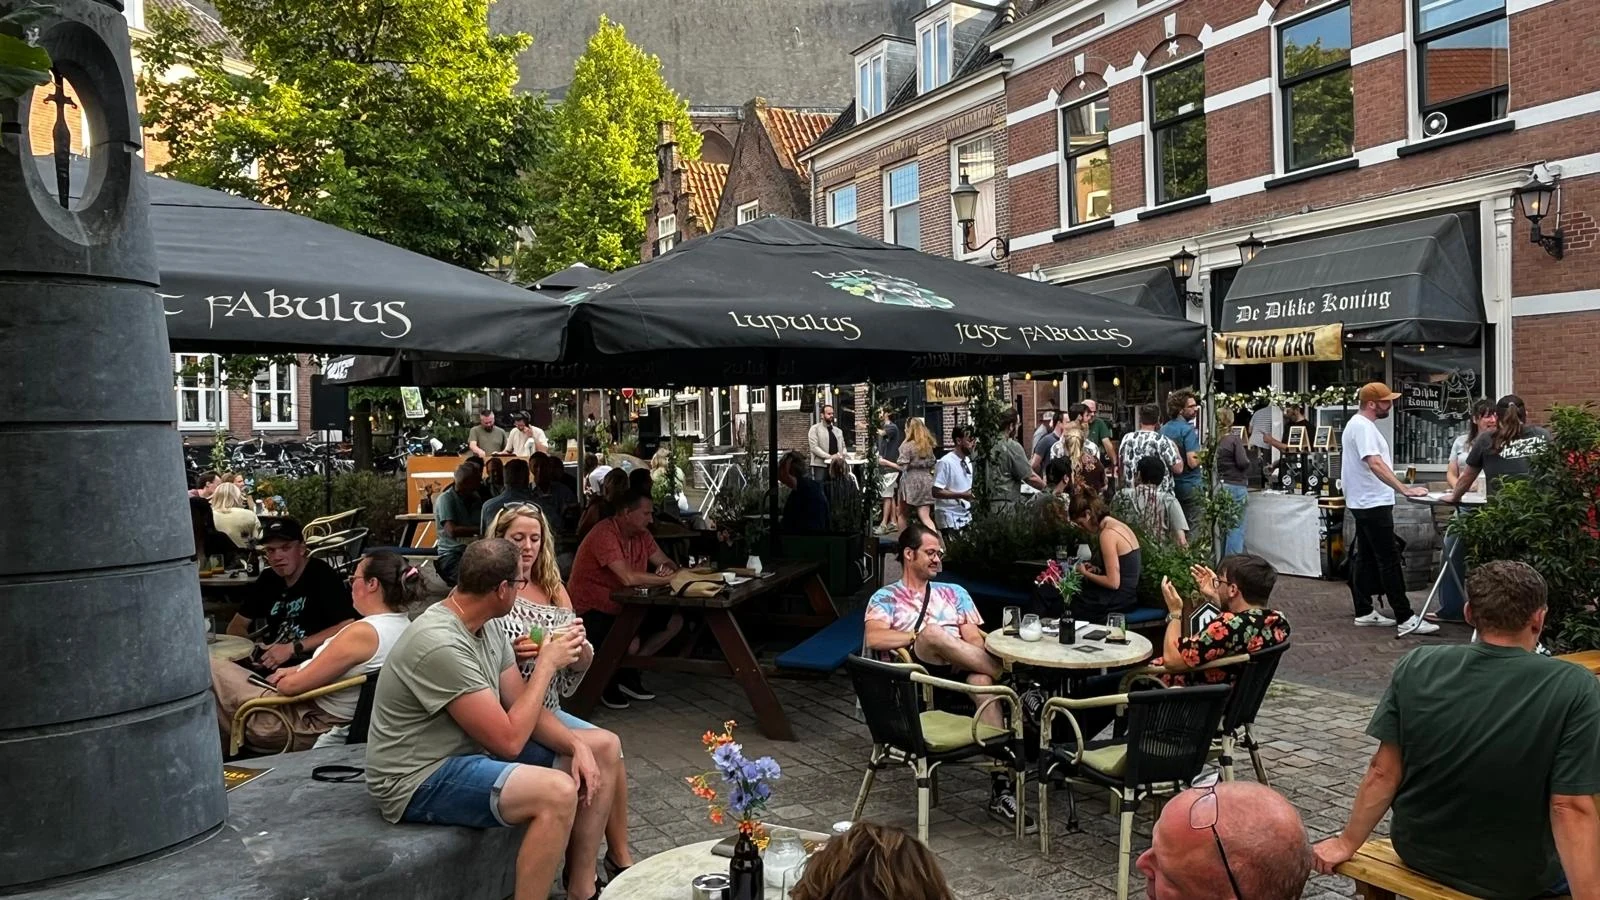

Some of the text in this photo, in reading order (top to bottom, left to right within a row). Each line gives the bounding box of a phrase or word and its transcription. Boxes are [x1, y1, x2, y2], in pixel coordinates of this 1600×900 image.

[1235, 289, 1392, 323] De Dikke Koning
[1225, 331, 1316, 360] DE BIER BAR
[1412, 387, 1438, 398] Dikke
[1408, 397, 1440, 409] Koning
